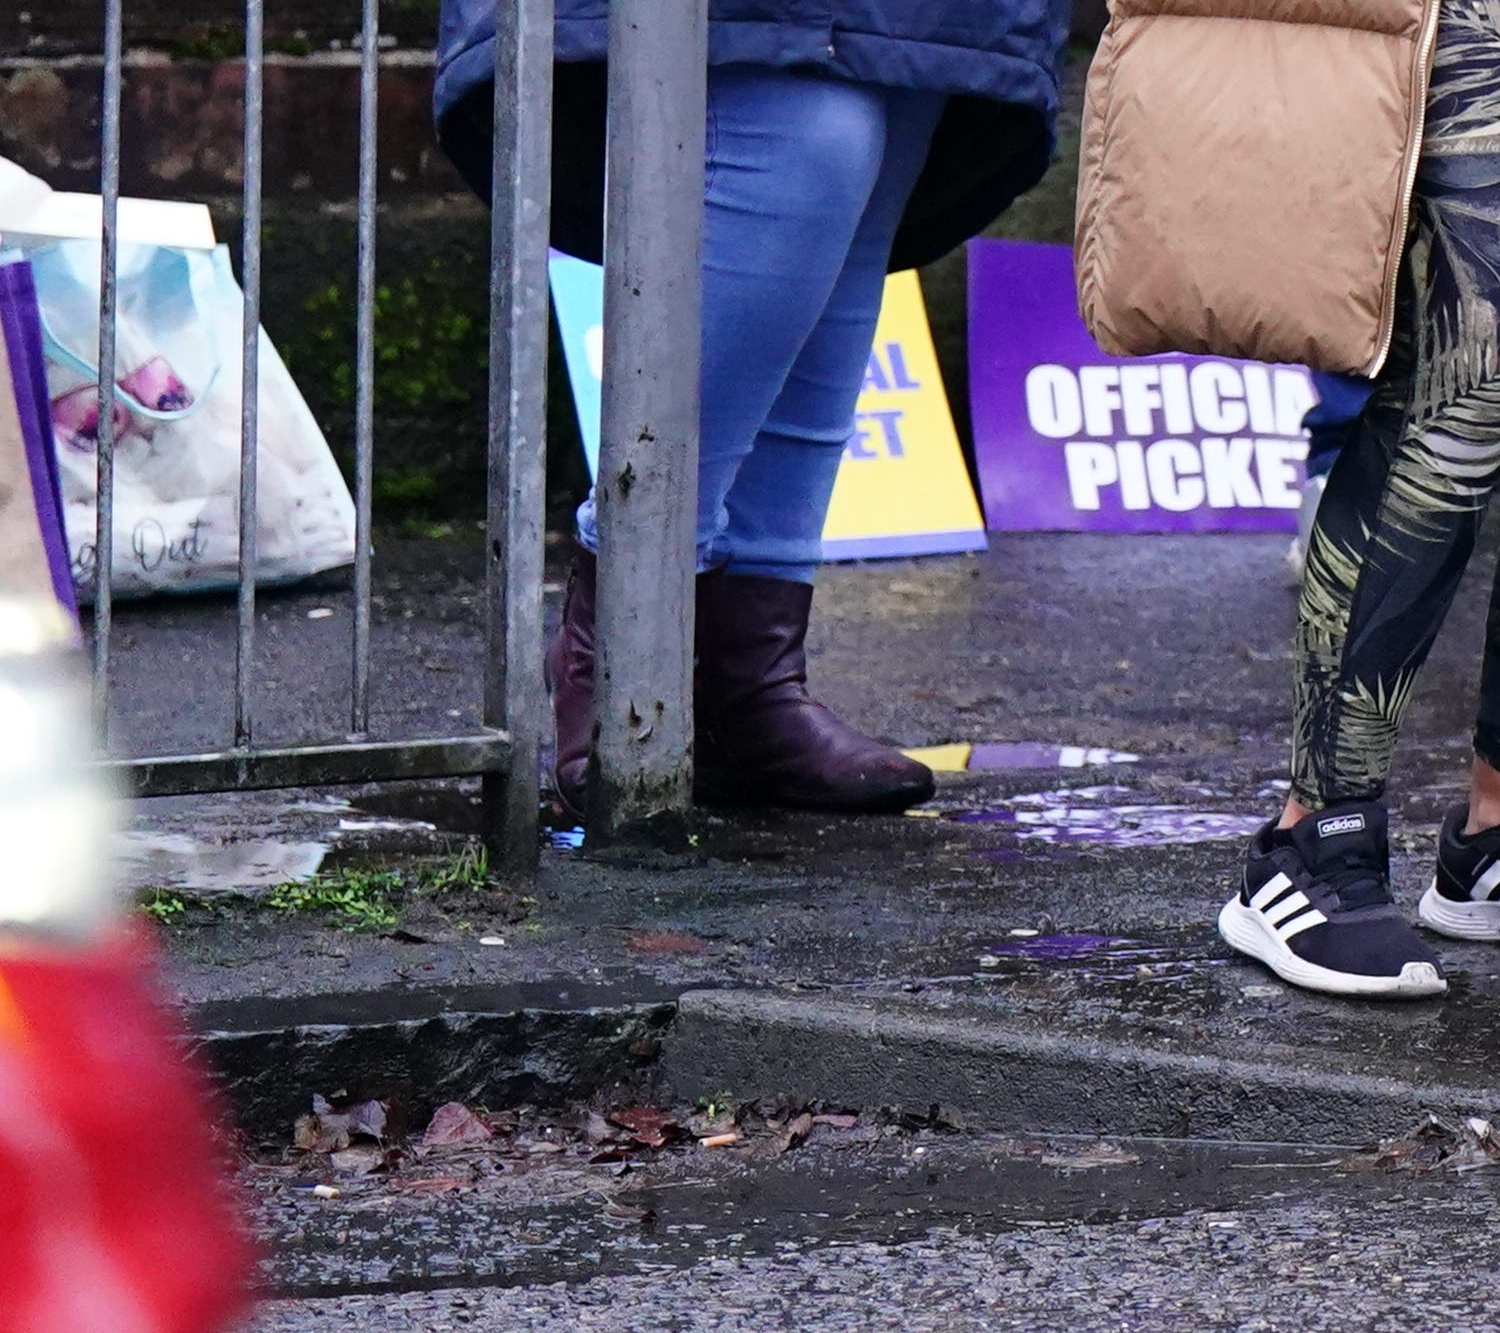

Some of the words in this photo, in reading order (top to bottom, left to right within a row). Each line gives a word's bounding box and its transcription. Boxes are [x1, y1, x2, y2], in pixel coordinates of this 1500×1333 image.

[1026, 362, 1320, 438] OFFICIA
[1065, 438, 1310, 512] PICKE
[1322, 817, 1362, 832] adidas
